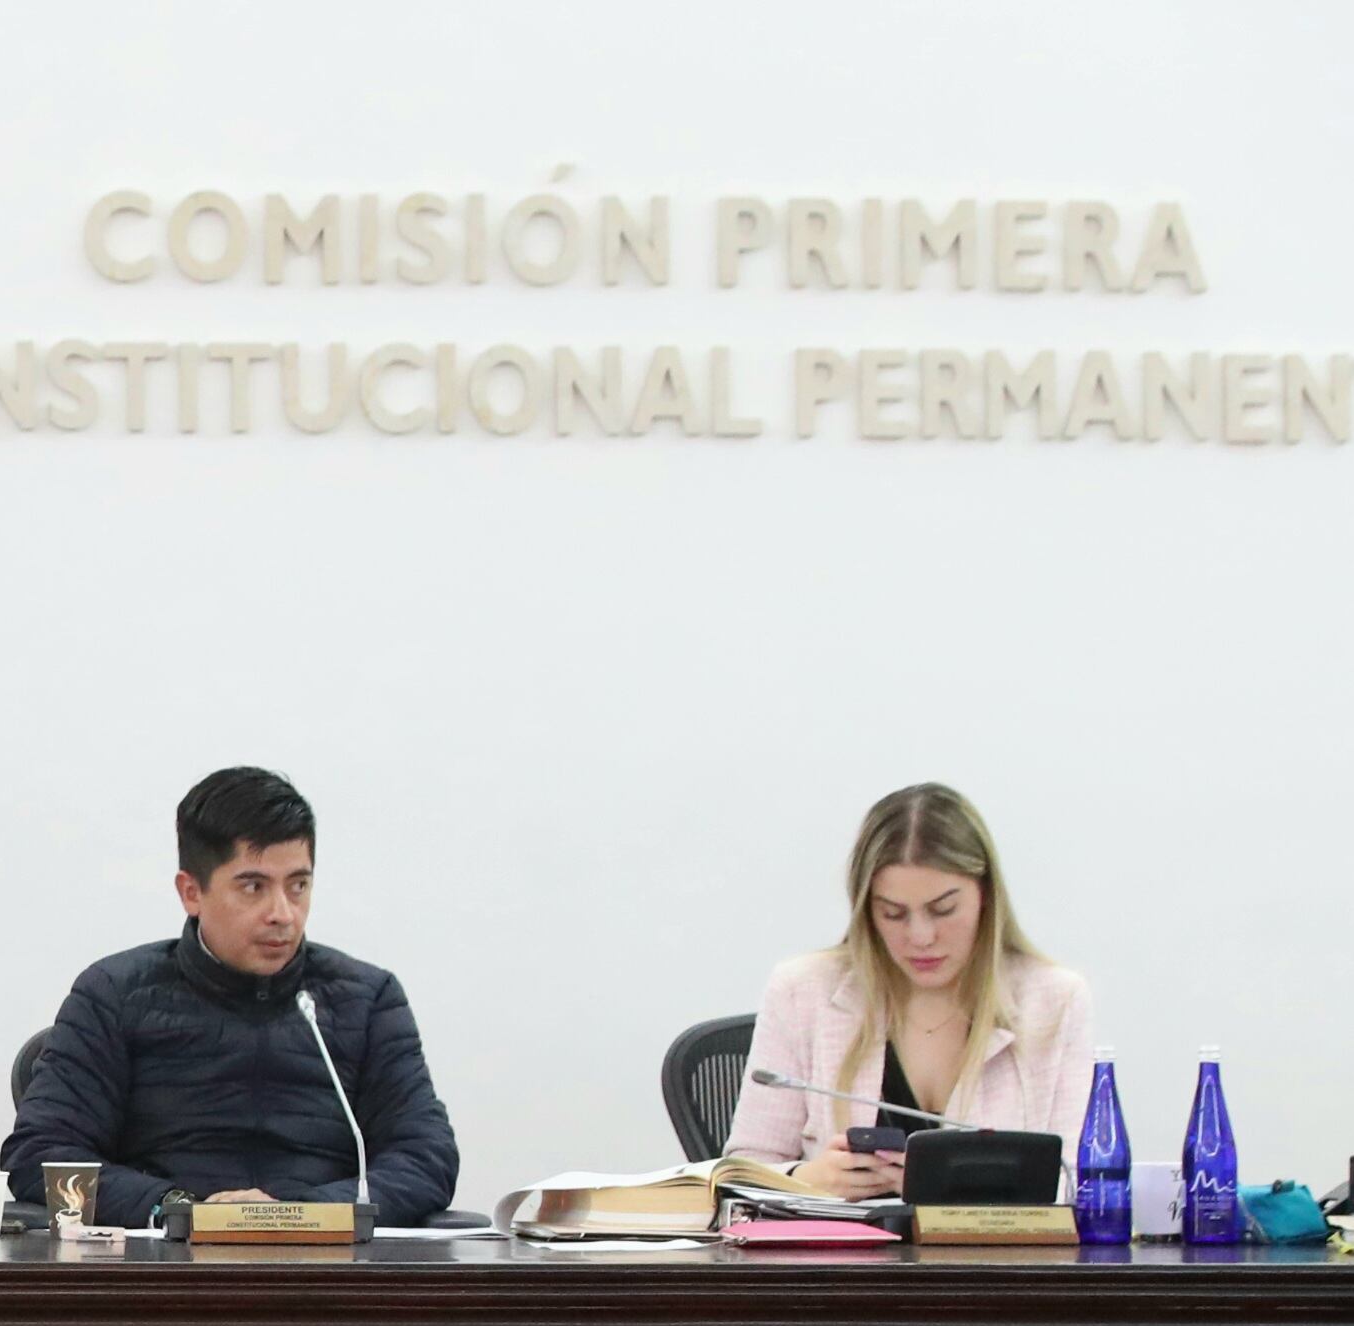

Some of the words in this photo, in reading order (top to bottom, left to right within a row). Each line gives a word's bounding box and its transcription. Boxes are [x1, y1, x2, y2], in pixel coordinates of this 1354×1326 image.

[82, 162, 672, 287] COMISIÓN
[715, 196, 1208, 294] PRIMERA
[793, 347, 1354, 446] PERMANEN
[241, 1206, 305, 1214] PRESIDENTE
